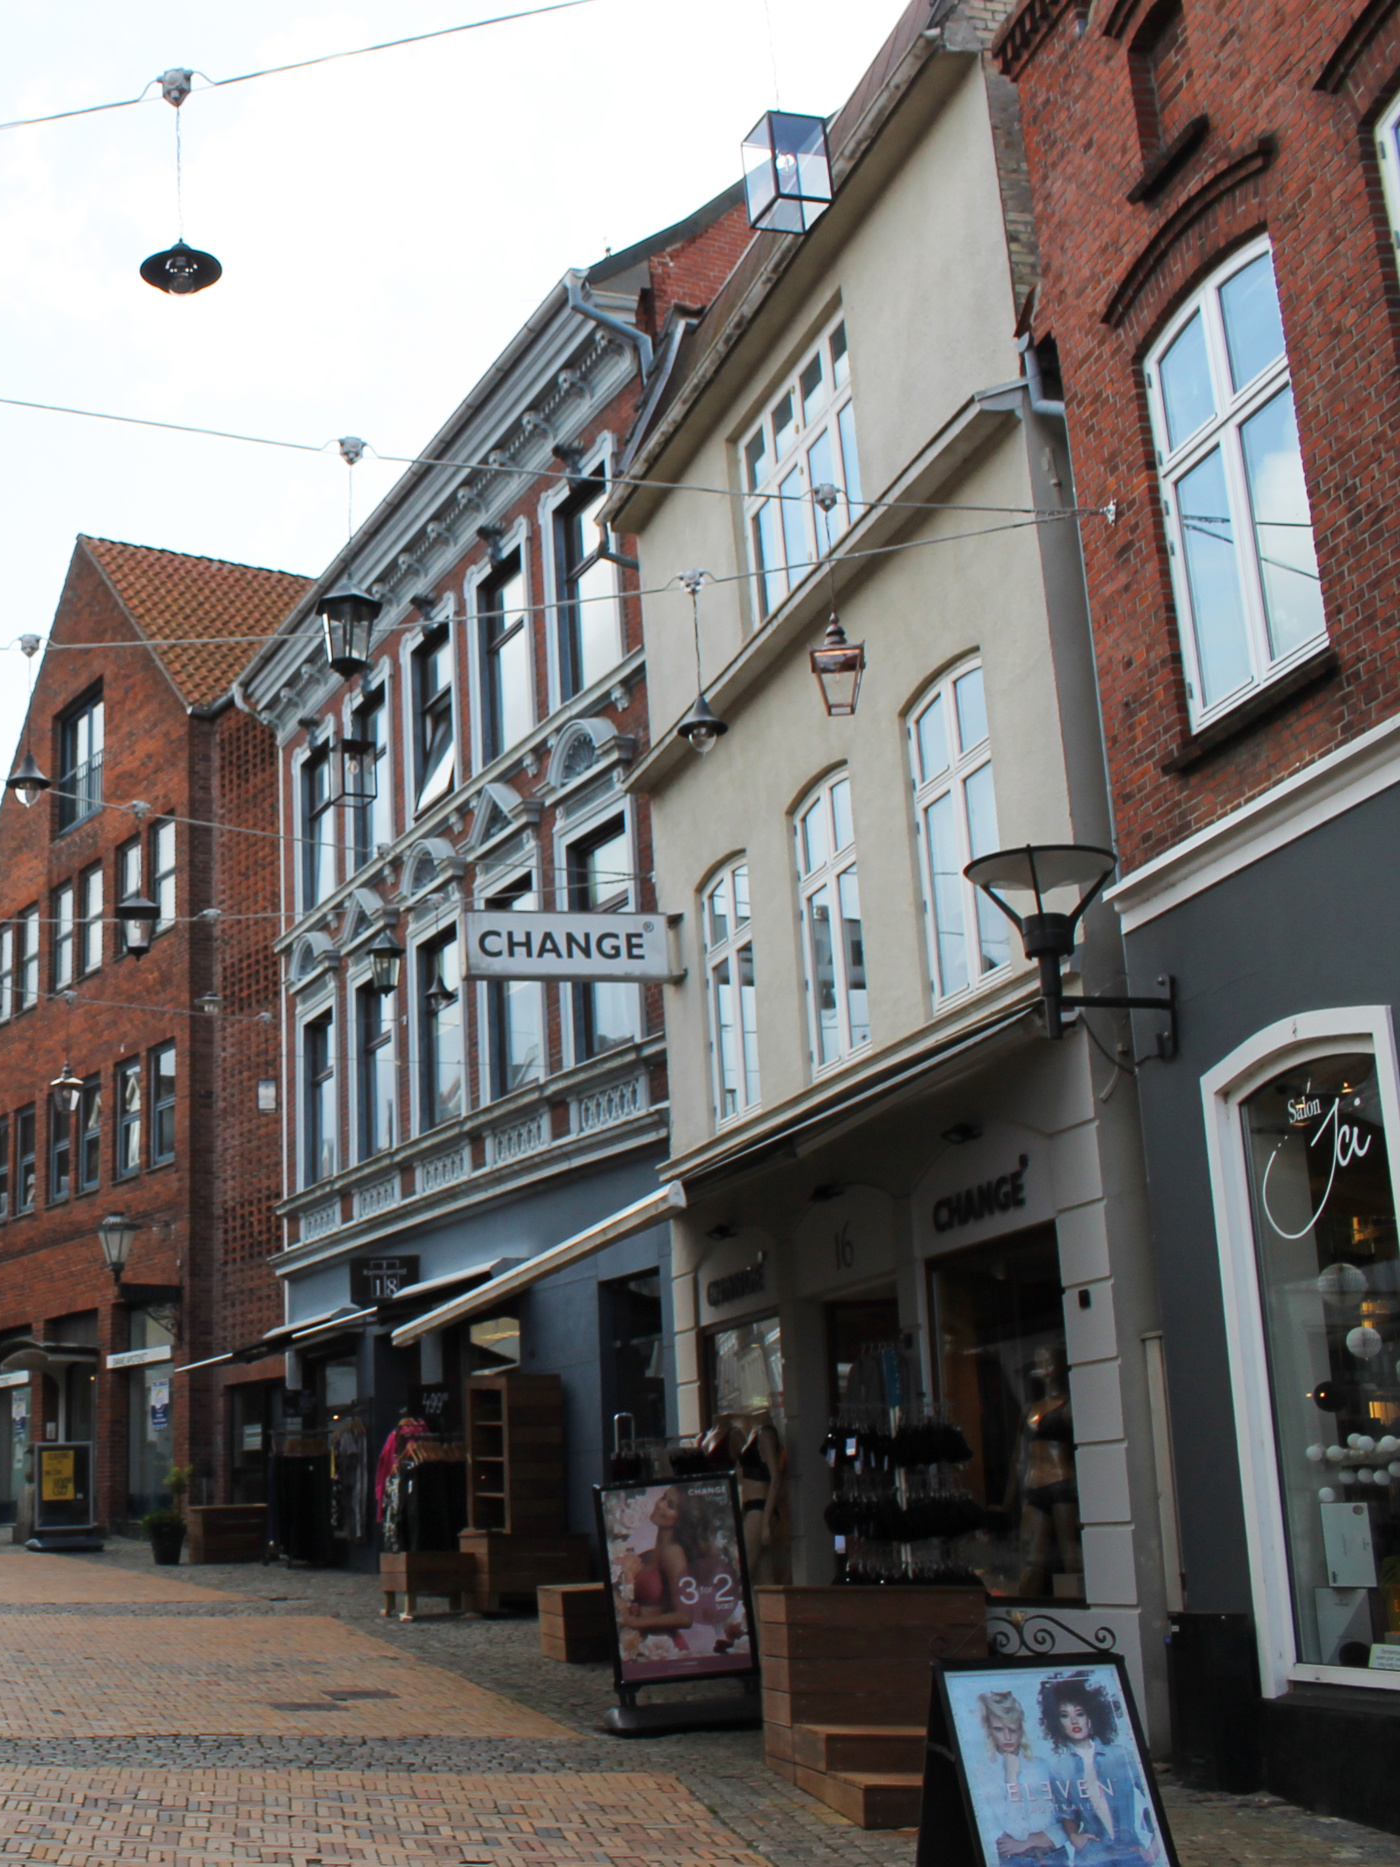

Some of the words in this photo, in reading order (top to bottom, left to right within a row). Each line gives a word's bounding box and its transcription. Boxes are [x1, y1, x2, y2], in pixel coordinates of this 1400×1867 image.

[1287, 1097, 1322, 1123] Salon
[834, 1221, 854, 1271] 16
[375, 1278, 398, 1297] 18
[678, 1576, 699, 1605] 3
[713, 1574, 735, 1602] 2
